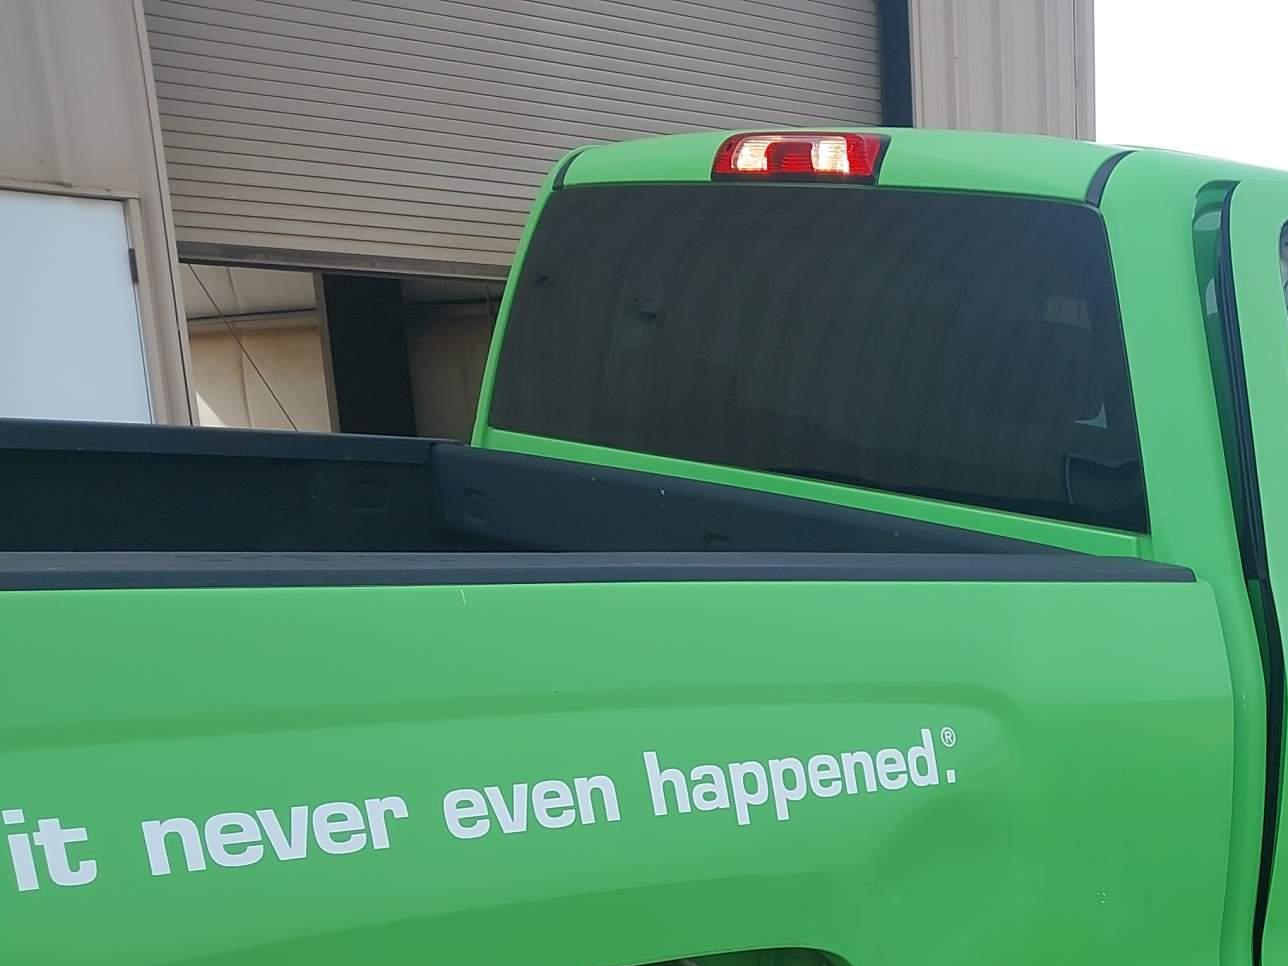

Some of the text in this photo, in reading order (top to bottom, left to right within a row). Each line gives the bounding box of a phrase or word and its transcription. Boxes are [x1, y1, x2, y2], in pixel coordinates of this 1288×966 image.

[1, 808, 98, 891] it
[143, 794, 408, 877] never
[442, 773, 621, 841] even
